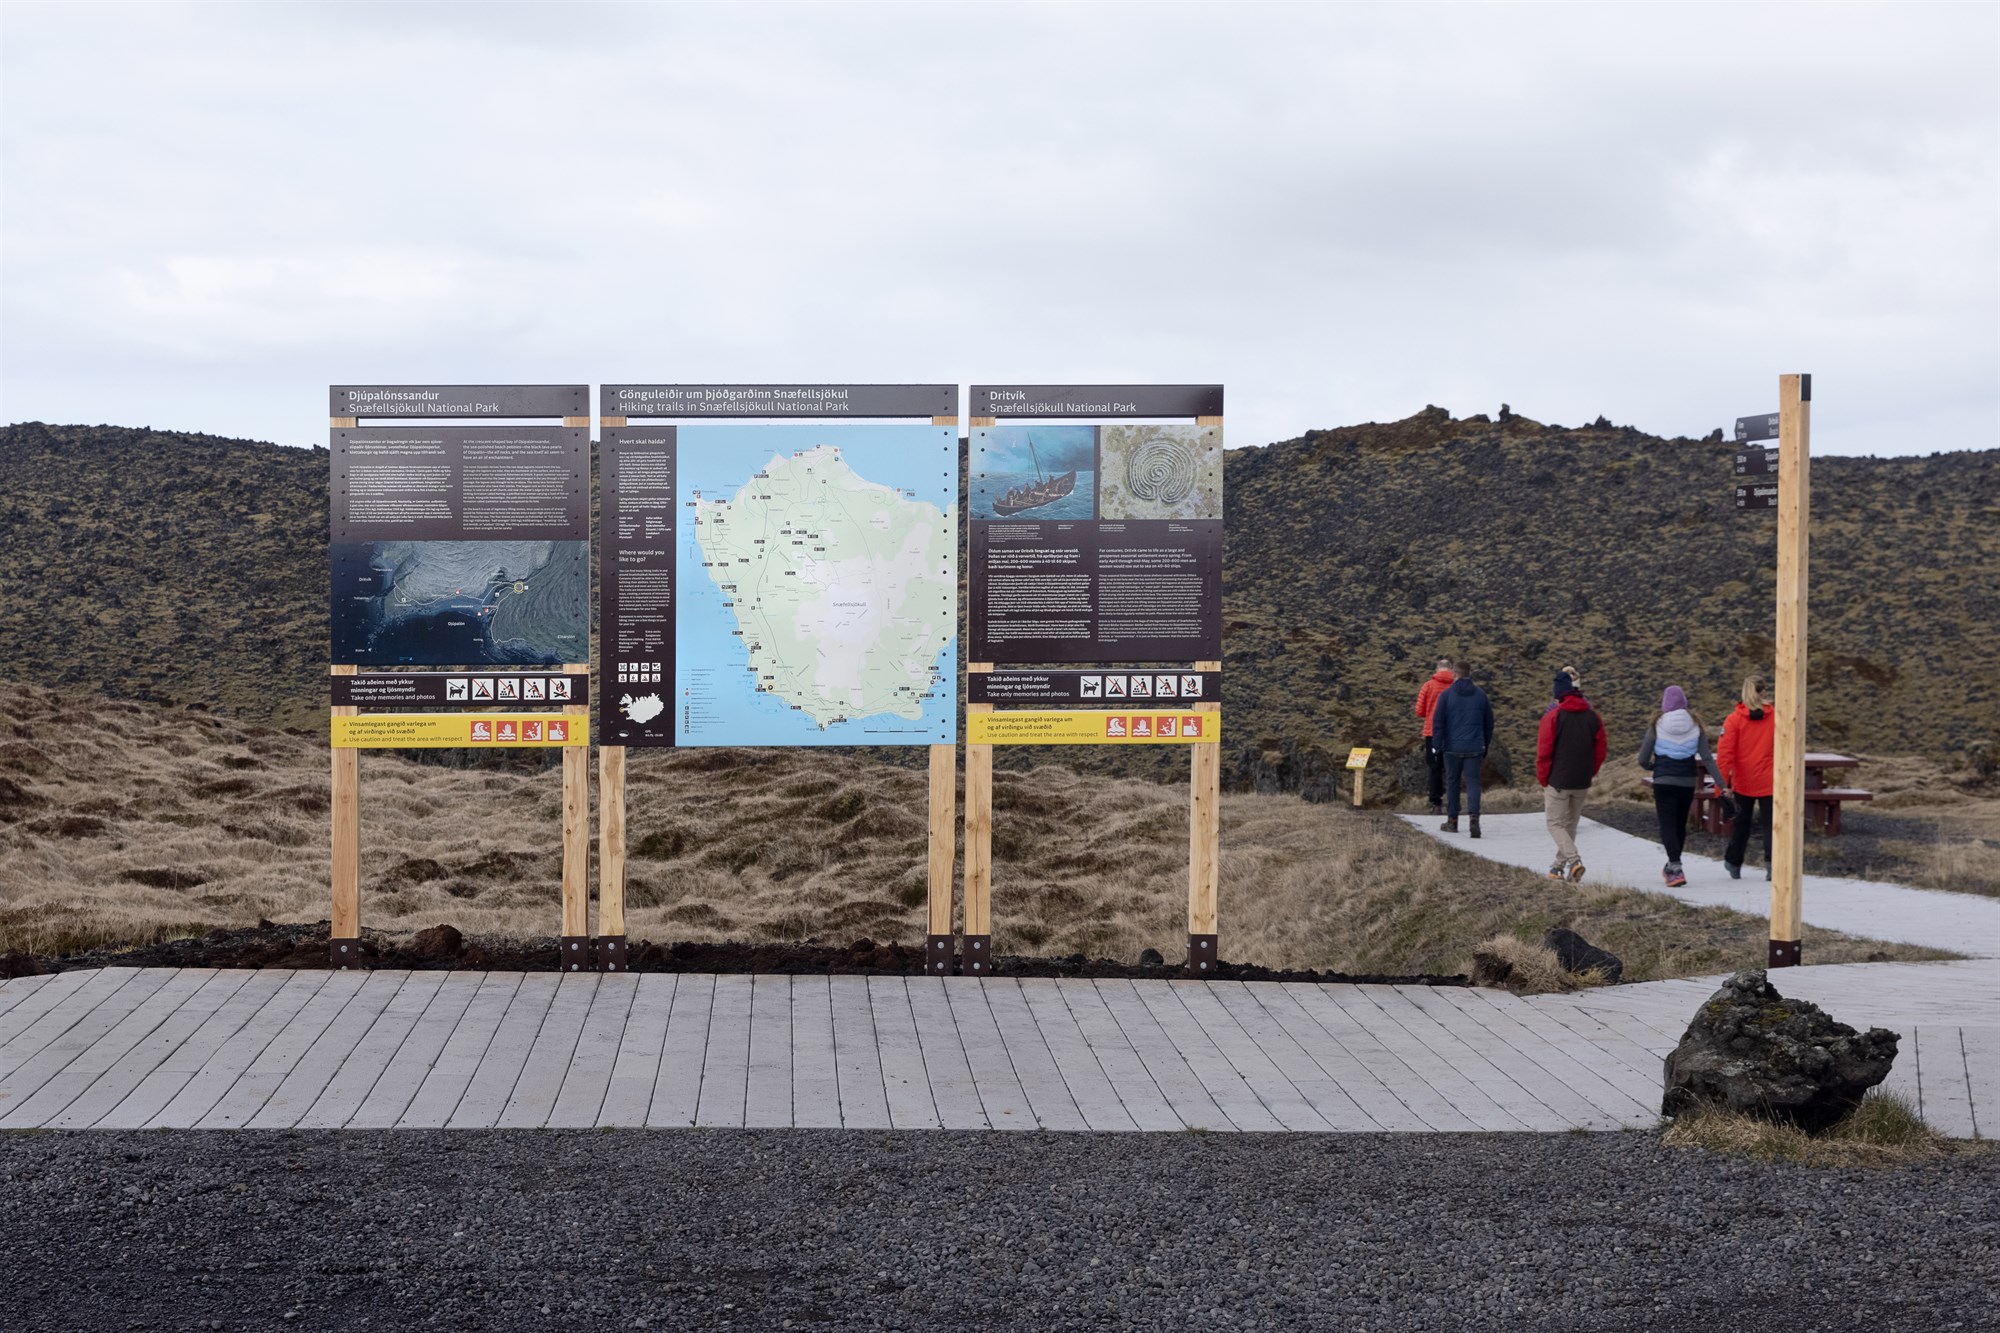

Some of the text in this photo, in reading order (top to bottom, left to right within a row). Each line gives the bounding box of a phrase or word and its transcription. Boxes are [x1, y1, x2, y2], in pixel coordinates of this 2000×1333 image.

[349, 390, 439, 402] Djúpalónssandur
[619, 389, 684, 402] Gönguleiðir
[705, 389, 771, 402] þjóðgarðinn
[774, 389, 848, 402] Snæfellsjökul
[990, 391, 1026, 400] Dritvík
[349, 402, 499, 415] Snæfellsjökull National Park
[619, 401, 849, 414] Hiking trails in Snæfellsjökull National Park
[990, 402, 1136, 414] Snæfellsjökull National Park
